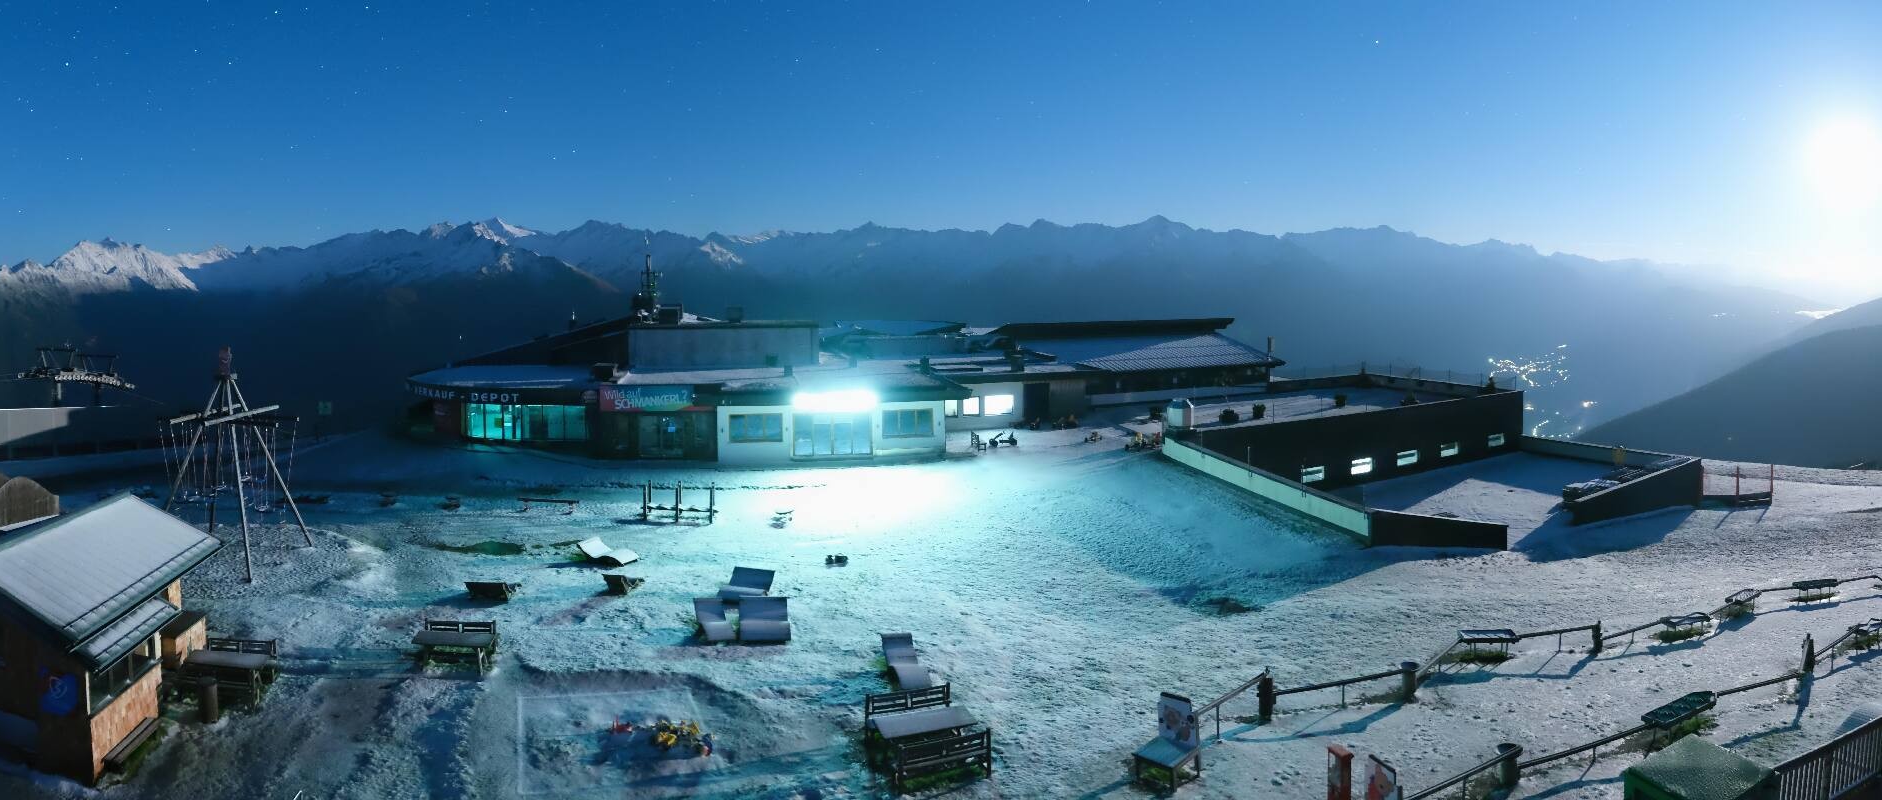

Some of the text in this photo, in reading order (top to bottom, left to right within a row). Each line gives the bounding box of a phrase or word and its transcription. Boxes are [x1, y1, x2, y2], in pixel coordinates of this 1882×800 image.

[471, 392, 520, 403] DEPOT
[604, 389, 625, 401] Wild
[626, 388, 641, 399] auf
[614, 389, 688, 410] SCHMANKERL?
